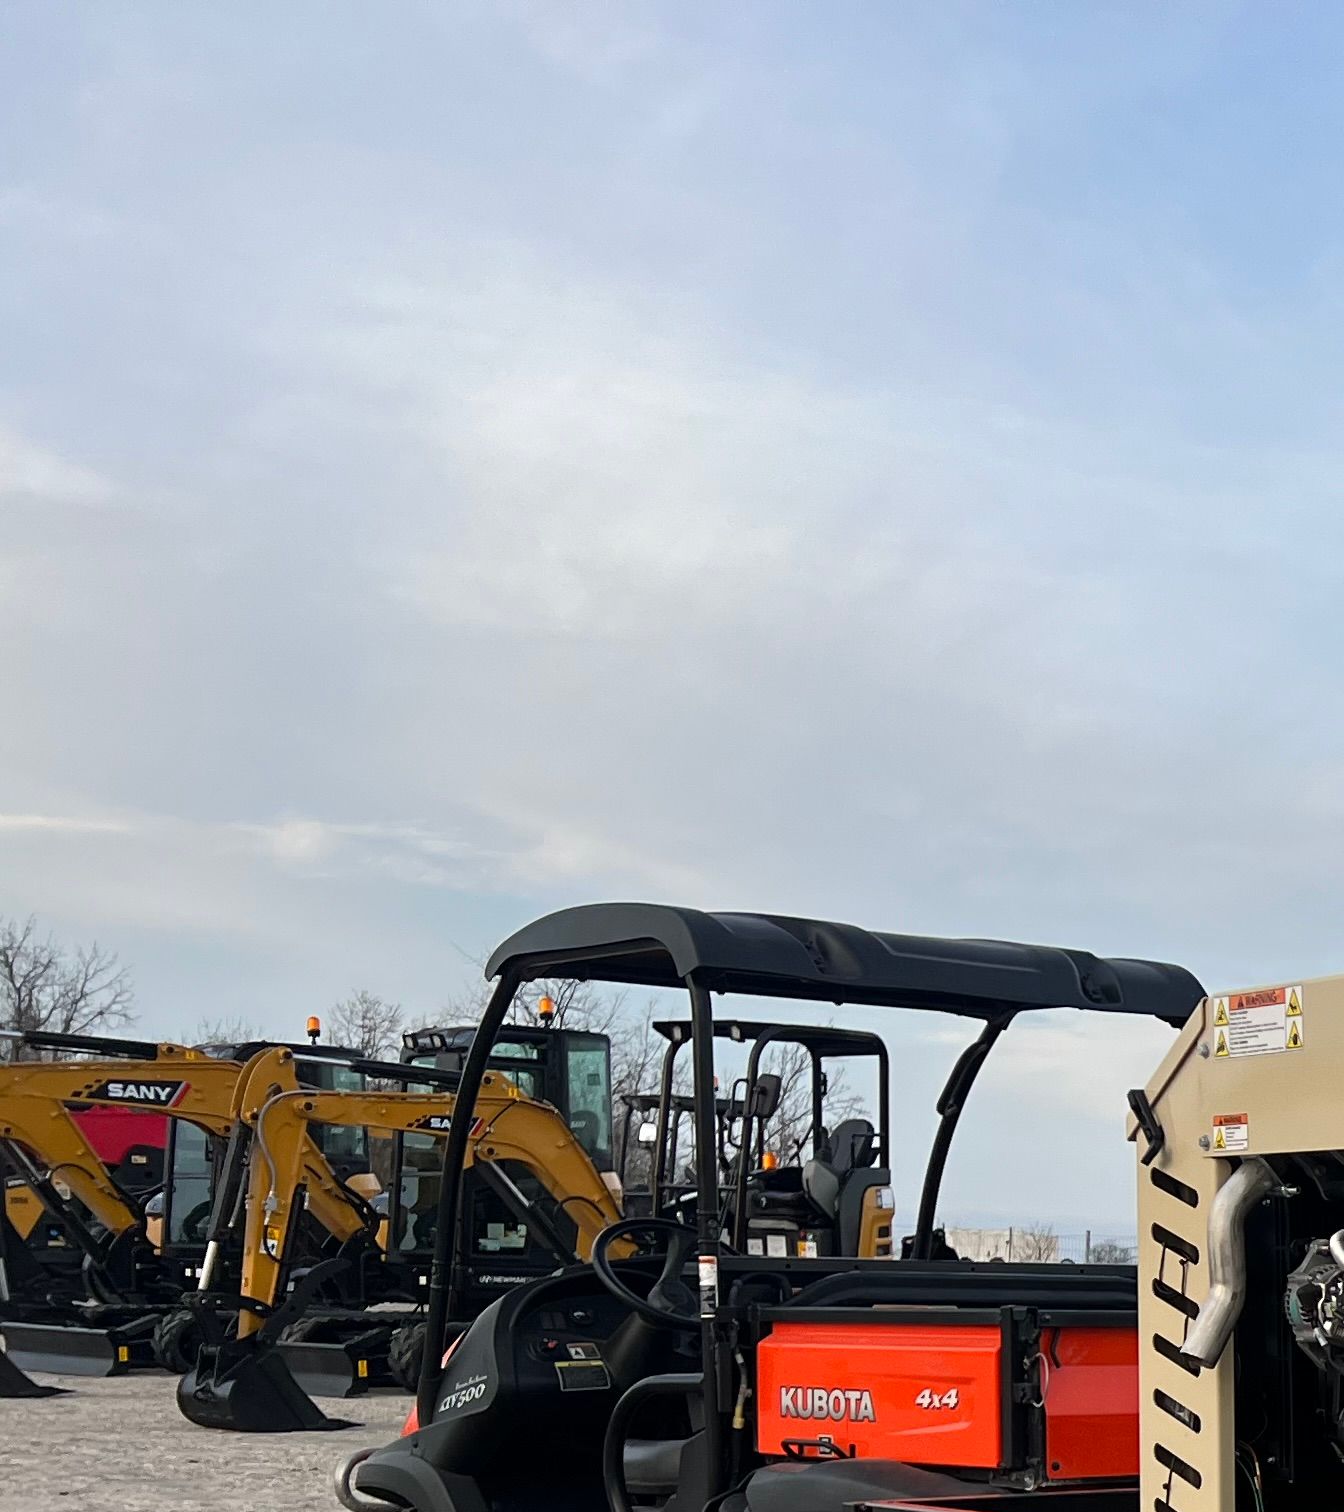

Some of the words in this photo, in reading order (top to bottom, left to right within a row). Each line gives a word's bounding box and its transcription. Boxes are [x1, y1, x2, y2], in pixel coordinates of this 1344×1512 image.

[106, 1082, 172, 1101] SANY
[780, 1386, 876, 1422] KUBOTA
[914, 1387, 960, 1411] 4x4
